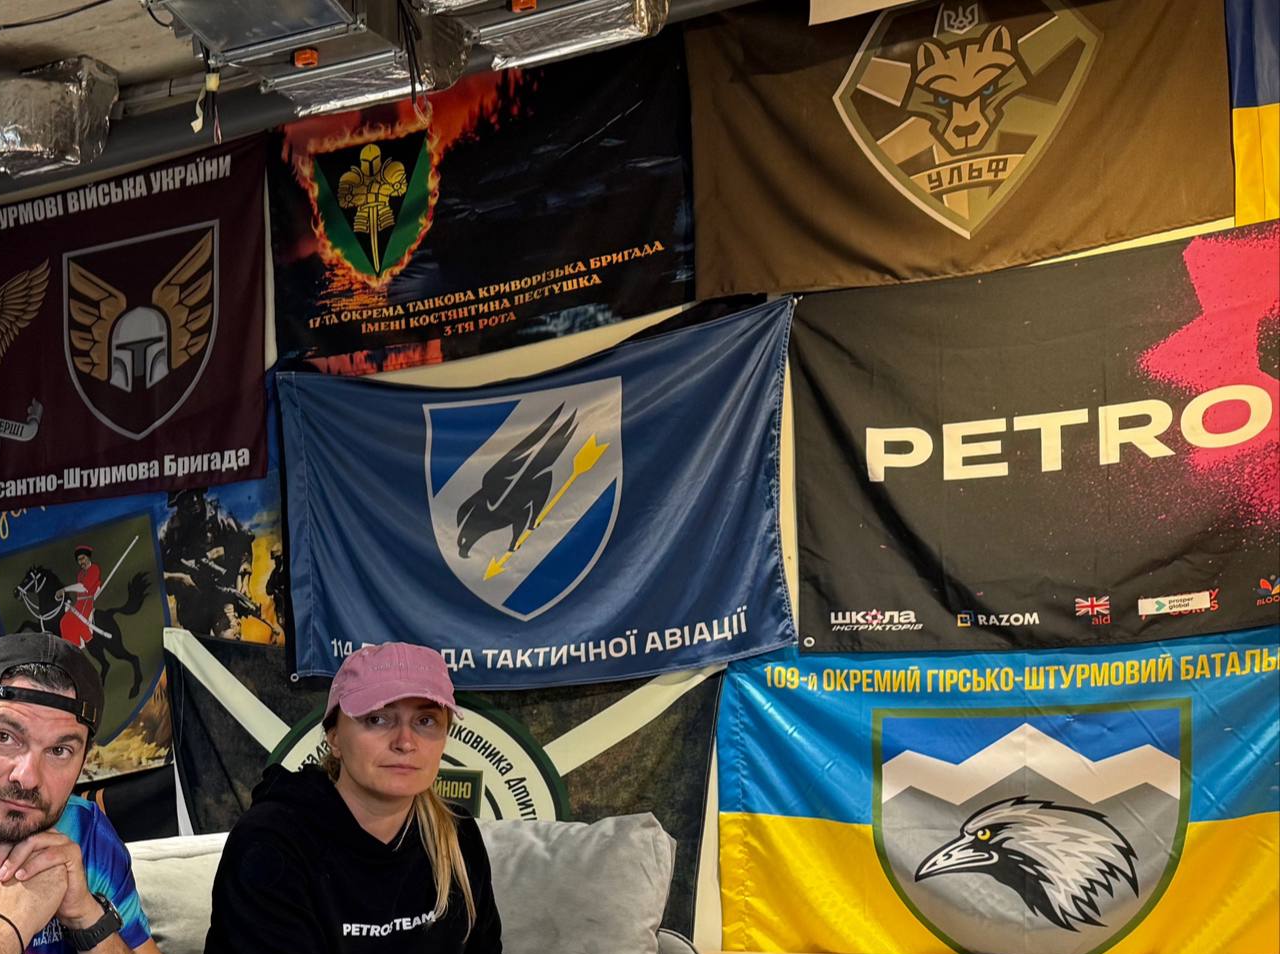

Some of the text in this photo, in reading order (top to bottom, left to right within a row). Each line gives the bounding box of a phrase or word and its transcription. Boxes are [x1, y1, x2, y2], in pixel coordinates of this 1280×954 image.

[66, 182, 148, 213] ВІЙСЬКА
[150, 155, 232, 196] УКРАЇНИ
[927, 157, 1009, 191] УЛЬФ
[341, 304, 405, 323] ОКРЕМА
[406, 289, 476, 314] ТАНКОВА
[477, 261, 587, 300] КРИВОРІЗЬКА
[589, 240, 665, 270] БРИГАДА
[361, 273, 603, 335] ІМЕНІ КОСТЯНТИНА ПЕСТУШКА
[443, 311, 517, 337] 3-ТЯ РОТА
[864, 384, 1274, 483] PETRO
[163, 446, 251, 478] Бригада
[482, 630, 638, 669] ТАКТИЧНОЇ
[644, 605, 748, 654] АВІАЦІЇ
[977, 612, 1040, 627] RAZOM
[1092, 614, 1111, 625] aid
[763, 665, 818, 691] 109-й
[822, 665, 921, 693] ОКРЕМИЙ
[926, 655, 1173, 693] ГІРСЬКО-ШТУРМОВИЙ
[393, 910, 436, 931] TEAM
